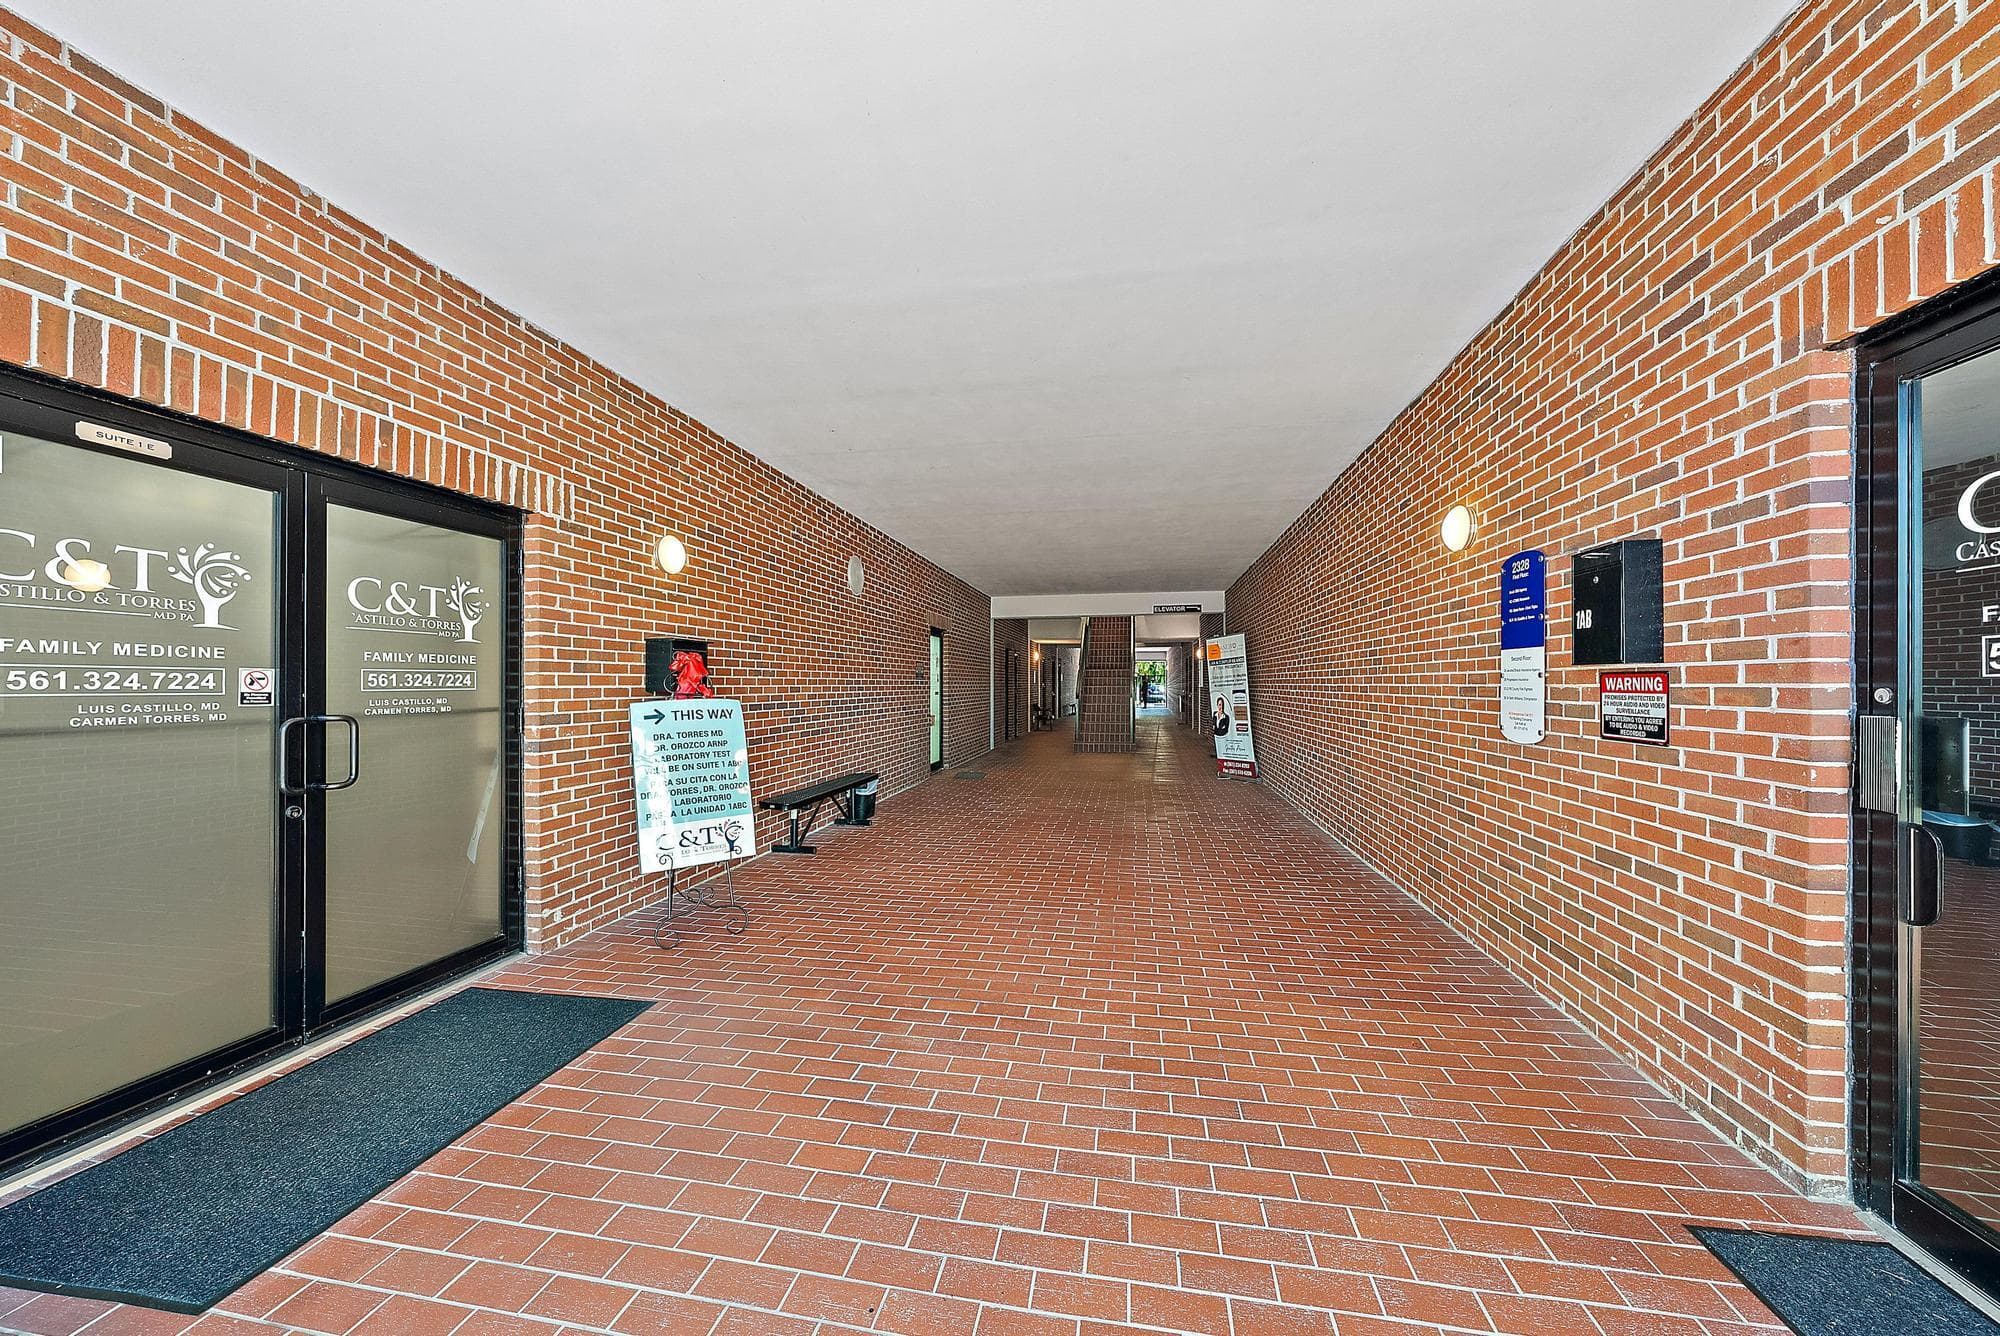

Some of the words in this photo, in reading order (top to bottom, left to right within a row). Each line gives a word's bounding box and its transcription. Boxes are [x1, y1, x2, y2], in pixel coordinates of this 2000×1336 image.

[96, 431, 134, 446] SUITE
[1512, 558, 1530, 574] 2328
[94, 592, 110, 605] &
[116, 592, 196, 612] TORRES
[347, 576, 446, 618] C&T
[153, 611, 177, 620] MD
[180, 612, 194, 622] PA
[352, 613, 406, 626] ASTILLO
[408, 618, 418, 628] &
[420, 618, 461, 630] TORRES
[1576, 609, 1592, 630] 1AB
[0, 638, 103, 656] FAMILY
[113, 643, 225, 660] MEDICINE
[364, 652, 414, 662] FAMILY
[418, 654, 477, 664] MEDICINE
[6, 670, 217, 691] 561.324.7224
[367, 674, 472, 687] 561.324.7224
[1605, 677, 1663, 692] WARNING
[78, 704, 115, 714] LUIS
[121, 702, 197, 713] CASTILLO,
[201, 702, 220, 710] MD
[670, 709, 704, 720] THIS
[706, 709, 733, 720] WAY
[70, 716, 138, 727] CARMEN
[142, 714, 204, 724] TORRES,
[208, 713, 227, 721] MD
[676, 730, 709, 739] TORRES
[670, 741, 705, 750] OROZCO
[707, 740, 728, 748] ARNP
[655, 752, 710, 762] ABORATORY
[712, 750, 730, 758] TEST
[696, 761, 720, 770] SUITE
[676, 777, 690, 785] SU
[692, 776, 708, 784] CITA
[710, 774, 726, 782] CON
[668, 786, 702, 796] ORRES,
[703, 784, 716, 792] DR.
[674, 793, 732, 806] LABORATORIO
[680, 808, 692, 816] LA
[694, 804, 726, 814] UNIDAD
[728, 802, 748, 810] 1ABC
